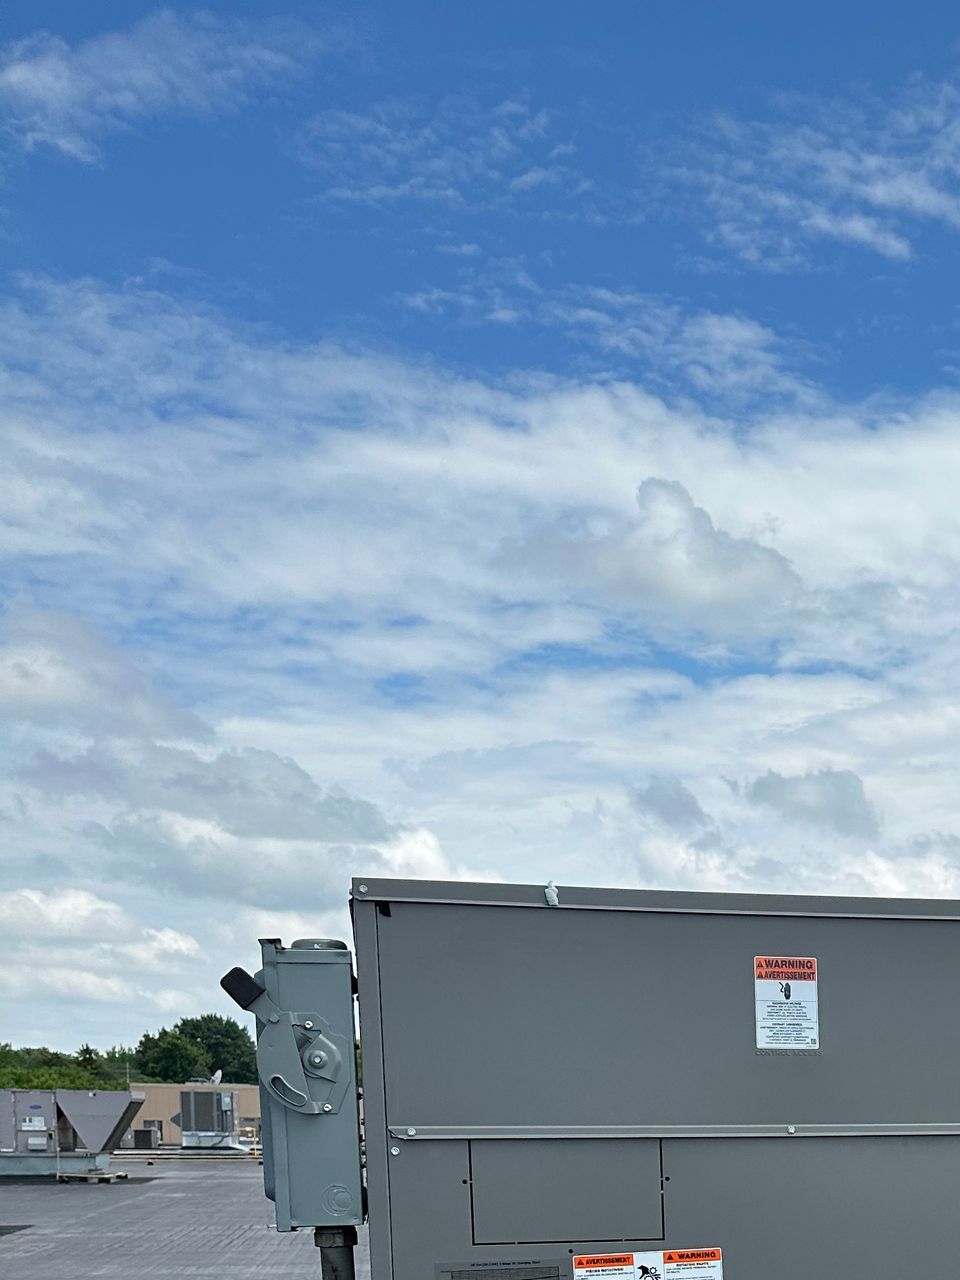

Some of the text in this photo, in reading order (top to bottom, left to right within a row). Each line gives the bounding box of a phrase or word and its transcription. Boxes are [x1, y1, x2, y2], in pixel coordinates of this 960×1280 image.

[765, 960, 813, 970] WARNING
[765, 971, 816, 981] AVERTISSEMENT
[677, 1251, 716, 1260] WARNING
[586, 1257, 631, 1265] AVERTISSEMENT
